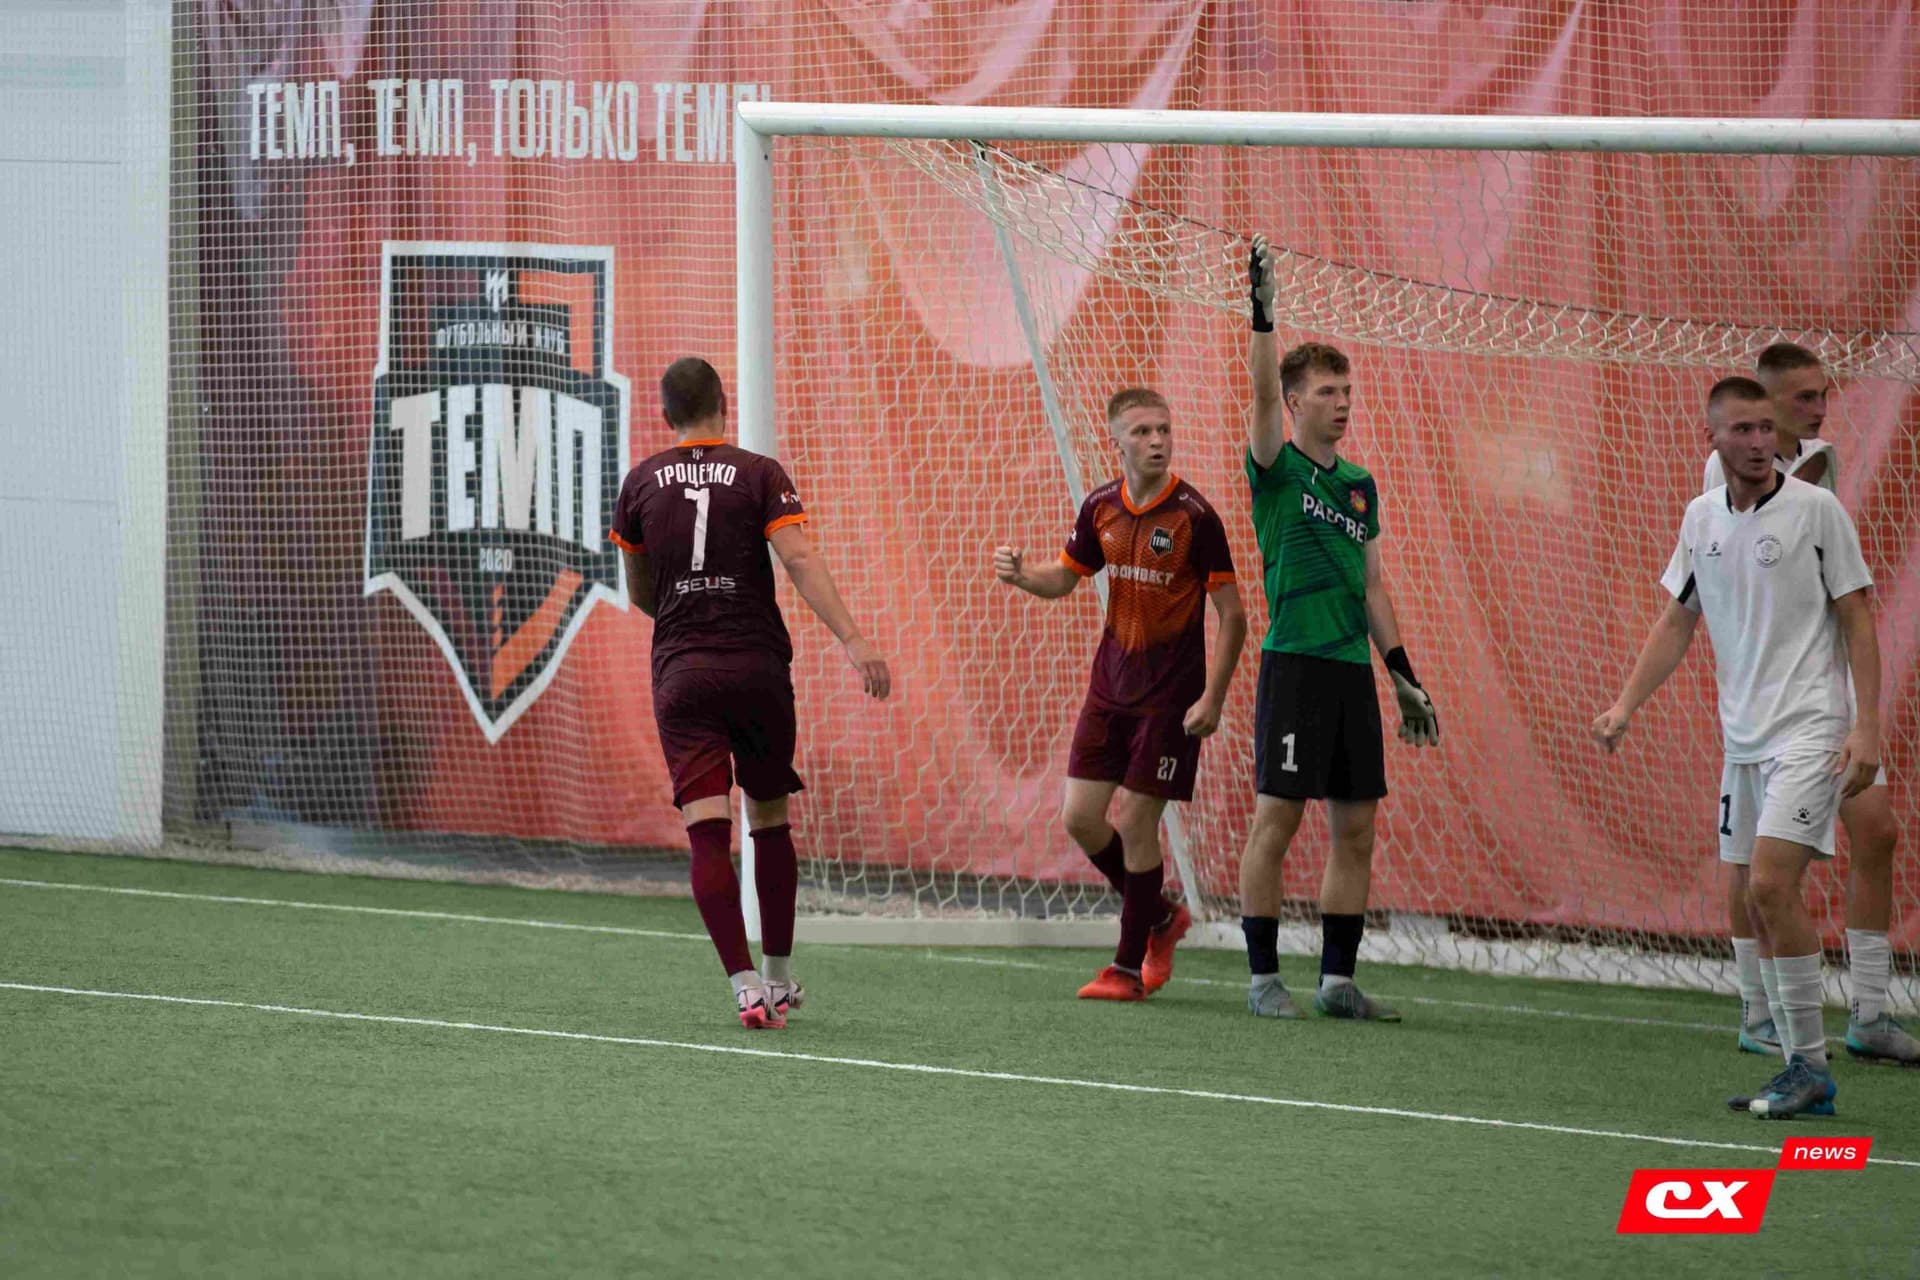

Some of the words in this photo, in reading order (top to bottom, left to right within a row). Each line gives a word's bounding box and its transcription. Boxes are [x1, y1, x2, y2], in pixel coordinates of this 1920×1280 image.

[247, 81, 355, 167] ТЕМП,
[367, 78, 477, 167] ТЕМП,
[489, 79, 638, 161] ТОЛЬКО
[436, 318, 527, 347] ФУТБОЛЬНЫЙ
[536, 326, 564, 353] КЛУБ
[391, 384, 602, 553] ТЕМП
[654, 462, 737, 488] ТРОЦЕНКО
[684, 488, 710, 571] 7
[479, 548, 512, 571] 2020
[675, 576, 736, 595] SEUS
[1157, 756, 1177, 781] 27
[1281, 733, 1298, 772] 1
[1720, 794, 1732, 836] 1
